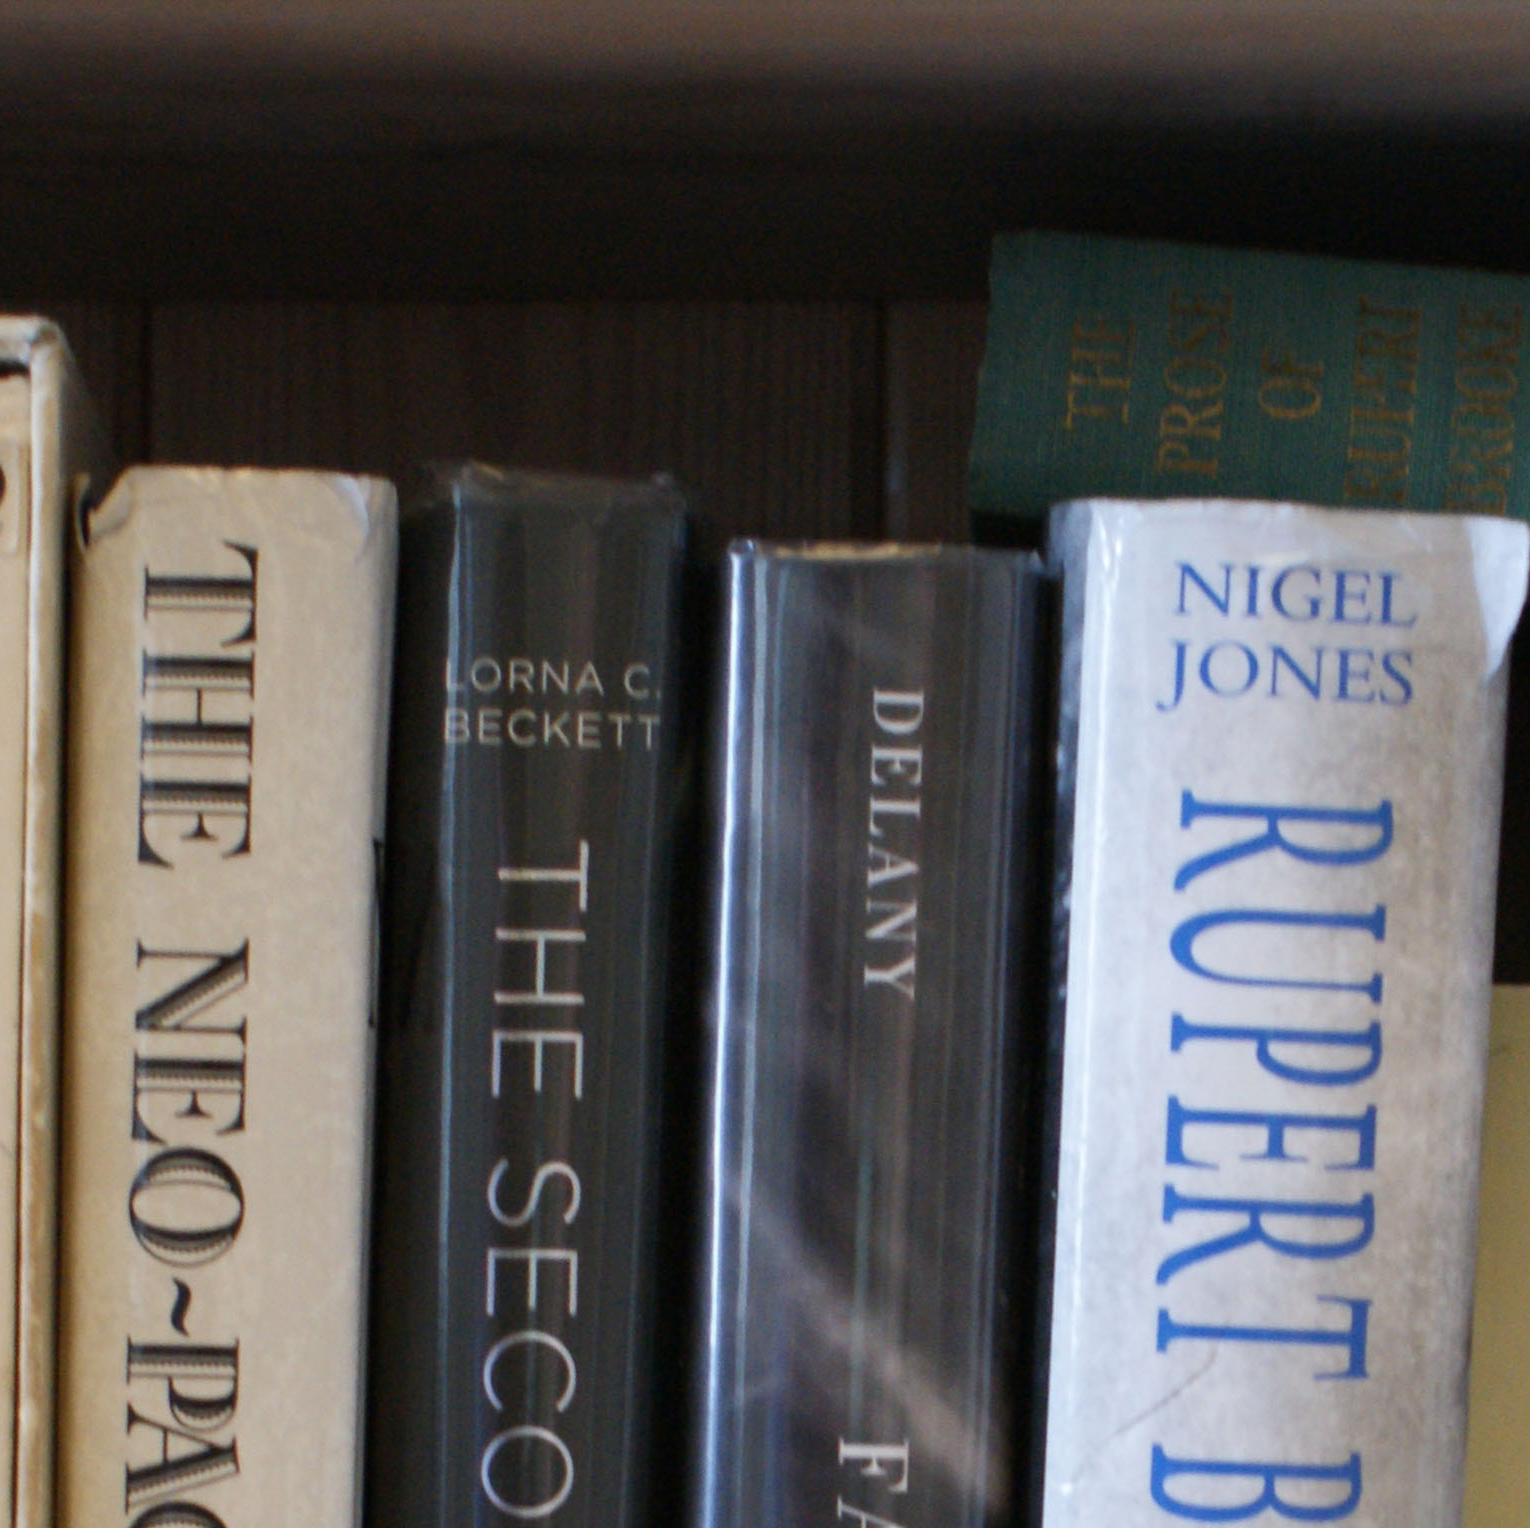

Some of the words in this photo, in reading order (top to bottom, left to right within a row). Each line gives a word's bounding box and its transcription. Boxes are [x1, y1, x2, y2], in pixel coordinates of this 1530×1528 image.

[443, 656, 607, 698] LORNA
[1155, 636, 1416, 714] JONES
[1173, 560, 1422, 630] NIGEL
[135, 538, 261, 872] THE
[442, 707, 663, 752] BECKETT
[862, 687, 926, 1002] DELANY
[490, 838, 590, 1100] THE
[1153, 788, 1395, 1382] RUPERT
